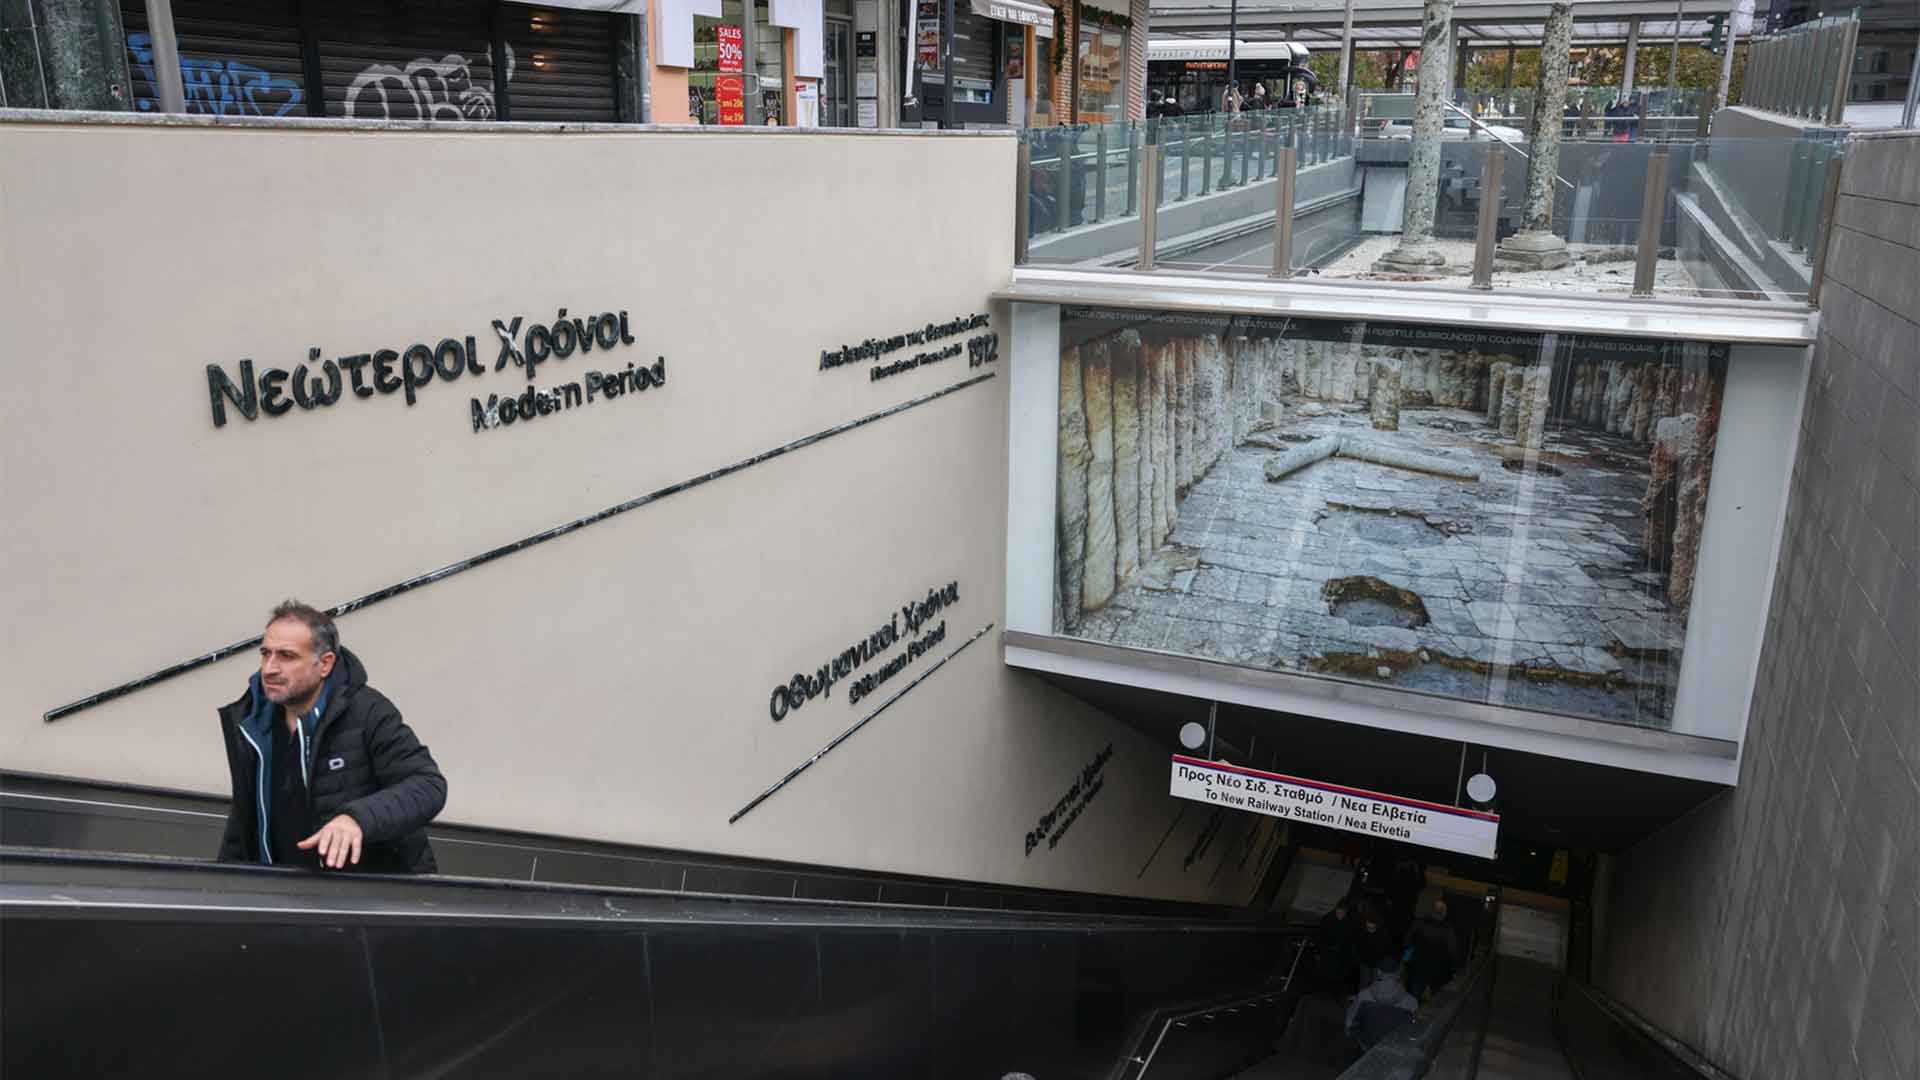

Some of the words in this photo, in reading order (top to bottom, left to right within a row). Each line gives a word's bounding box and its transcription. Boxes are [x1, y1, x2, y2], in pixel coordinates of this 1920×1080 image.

[719, 27, 741, 39] SALES
[719, 43, 742, 60] 50%
[206, 335, 486, 428] Νεώτεροι
[491, 308, 635, 380] Χρόνοι
[967, 332, 999, 369] 1912
[471, 383, 582, 434] Modern
[585, 355, 666, 402] Period
[770, 612, 899, 722] Οθωμανικοί
[902, 580, 960, 638] Χρόνοι
[849, 652, 907, 705] Ottoman
[907, 620, 946, 663] Period
[1179, 766, 1212, 786] Προς
[1216, 773, 1242, 788] Νέο
[1245, 779, 1270, 794] Σιδ.
[1274, 784, 1324, 805] Σταθμό
[1331, 795, 1338, 807] /
[1341, 797, 1367, 813] Νεα
[1372, 803, 1427, 824] Ελβετία
[1205, 788, 1218, 800] To
[1221, 791, 1244, 805] New
[1247, 796, 1291, 816] Railway
[1294, 805, 1335, 823] Station
[1344, 815, 1367, 830] Nea
[1370, 821, 1411, 839] Elvetia
